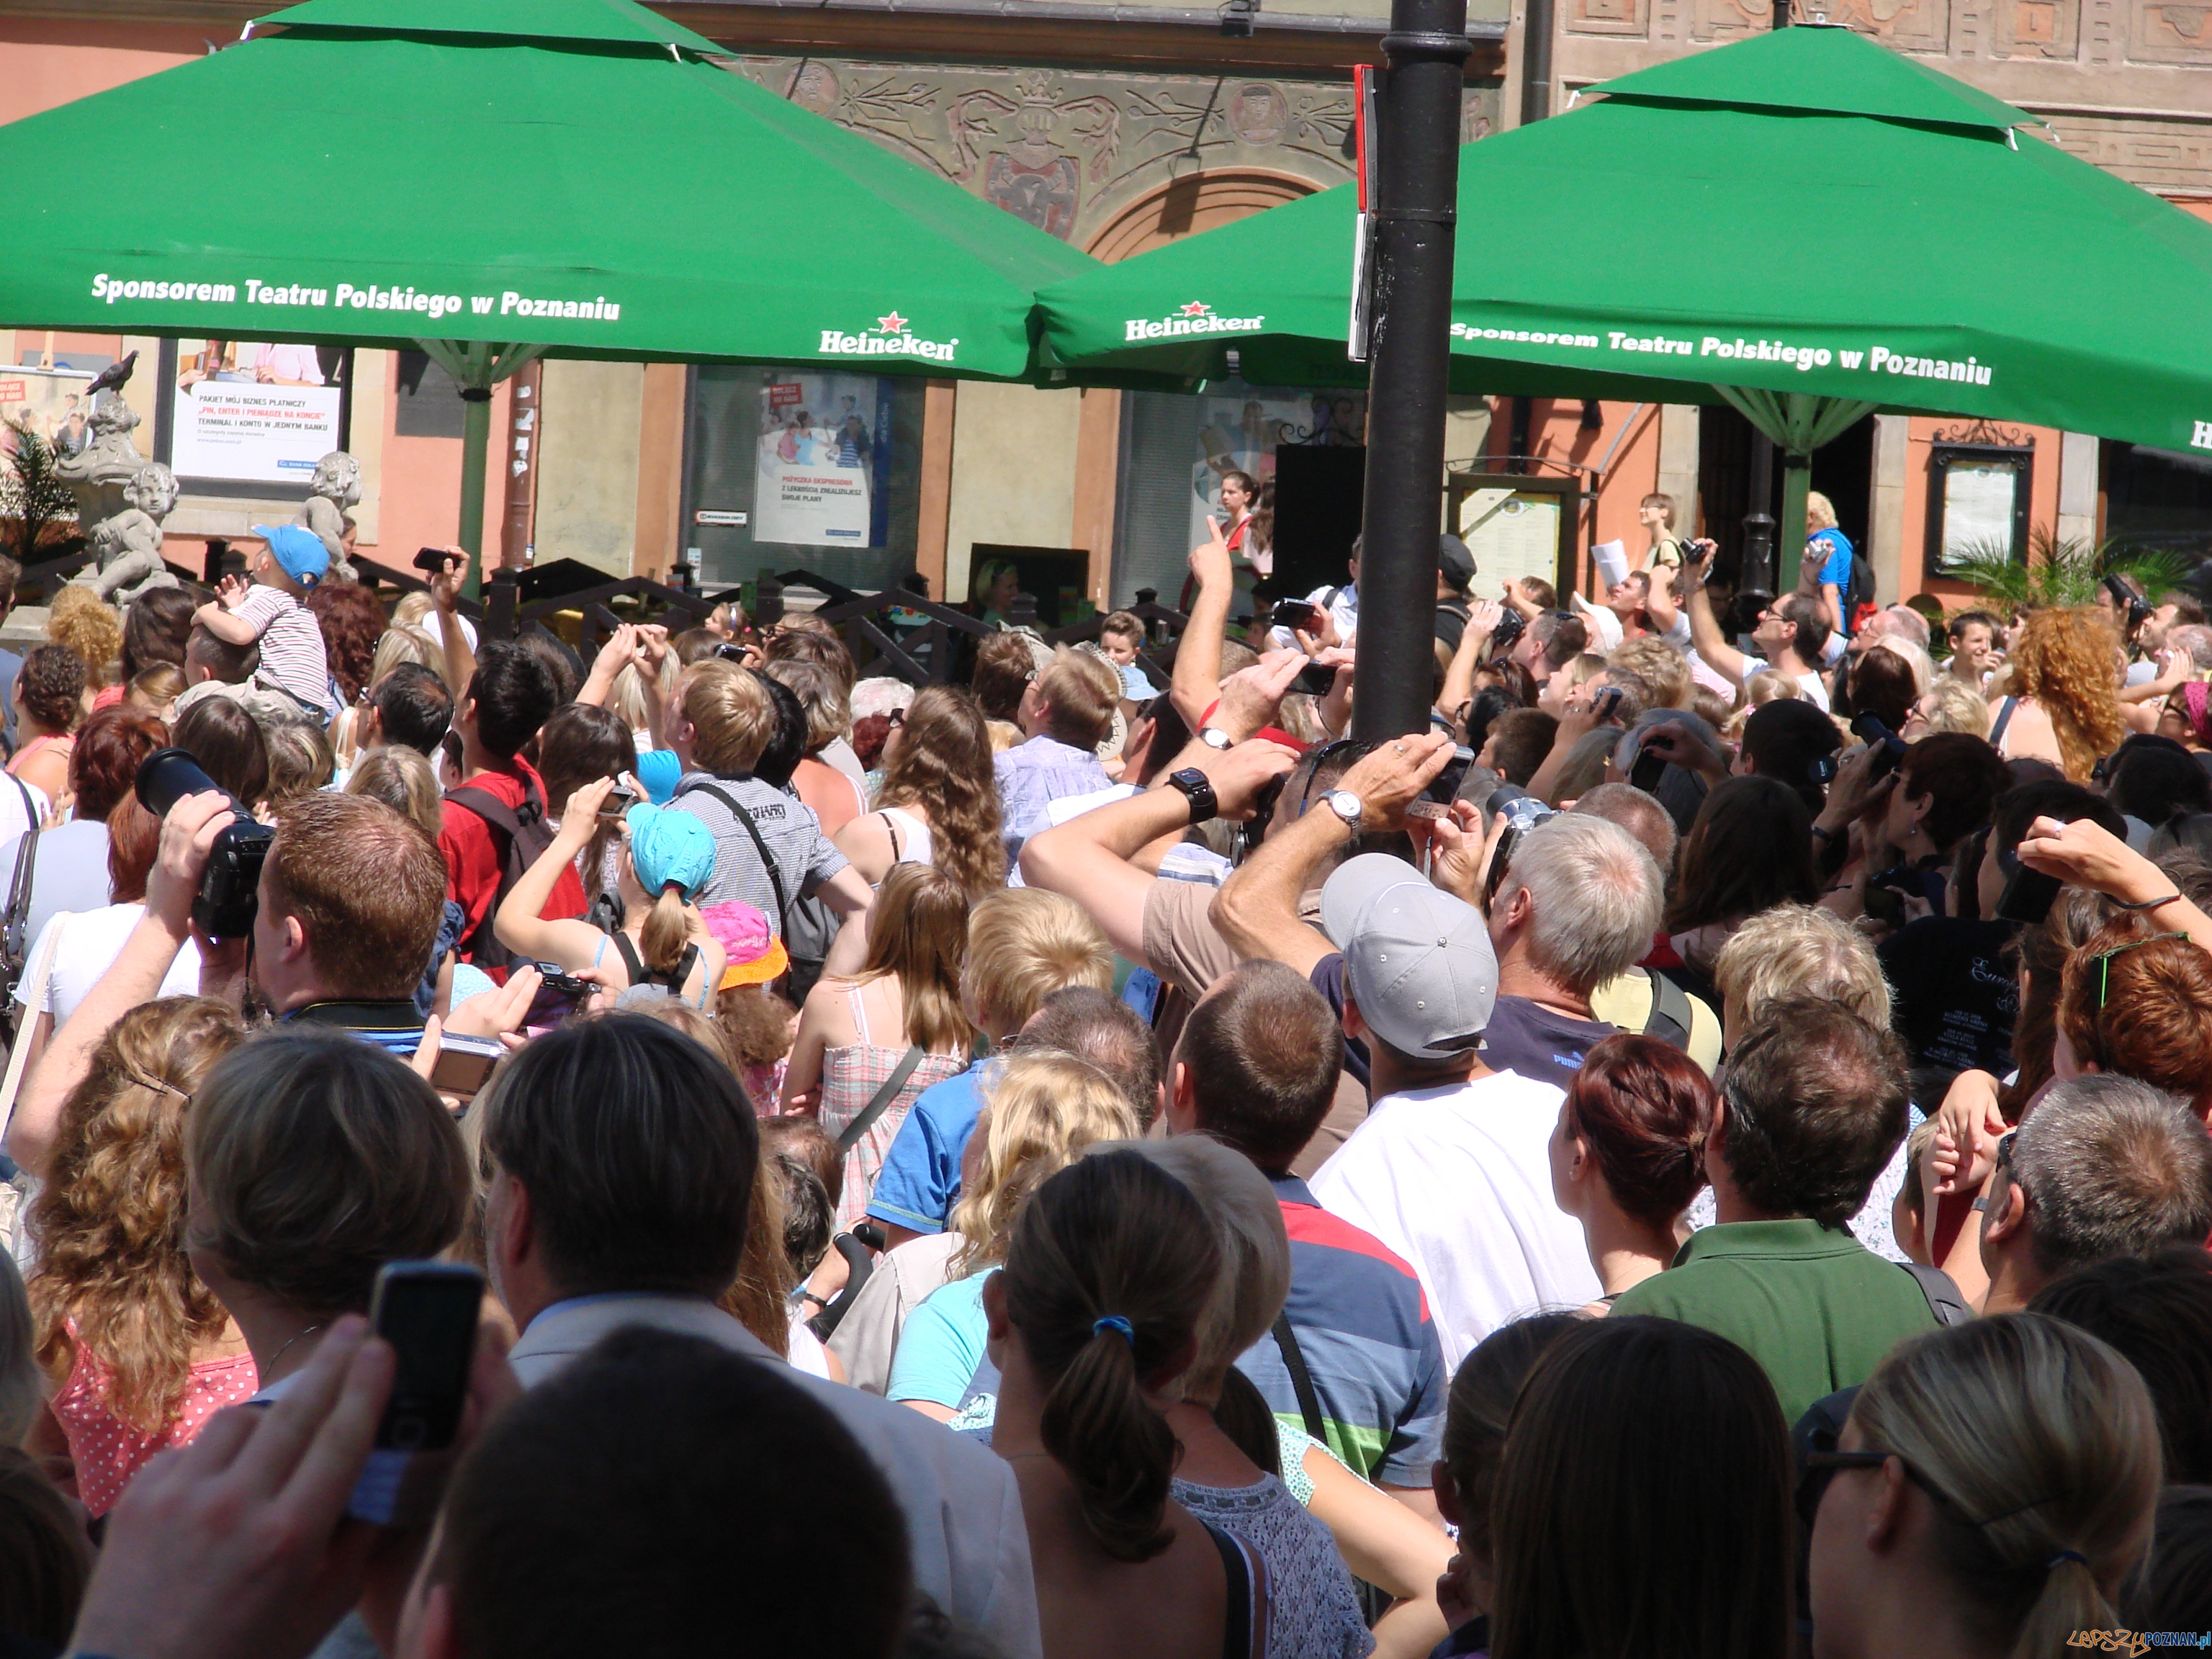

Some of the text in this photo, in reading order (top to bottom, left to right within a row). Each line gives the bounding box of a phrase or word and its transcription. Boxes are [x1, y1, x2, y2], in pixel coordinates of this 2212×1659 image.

[91, 274, 621, 321] Sponsorem Teatru Polskiego w Poznaniu
[1125, 315, 1262, 341] Heineken
[819, 331, 956, 361] Heineken
[1450, 323, 1992, 386] Sponsorem Teatru Polskiego w Poznaniu
[218, 407, 240, 415] ENTER
[247, 408, 282, 419] PIENIĄDZE
[225, 395, 240, 404] MÓJ
[269, 399, 306, 408] PŁATNICZY
[198, 418, 233, 426] TERMINAL
